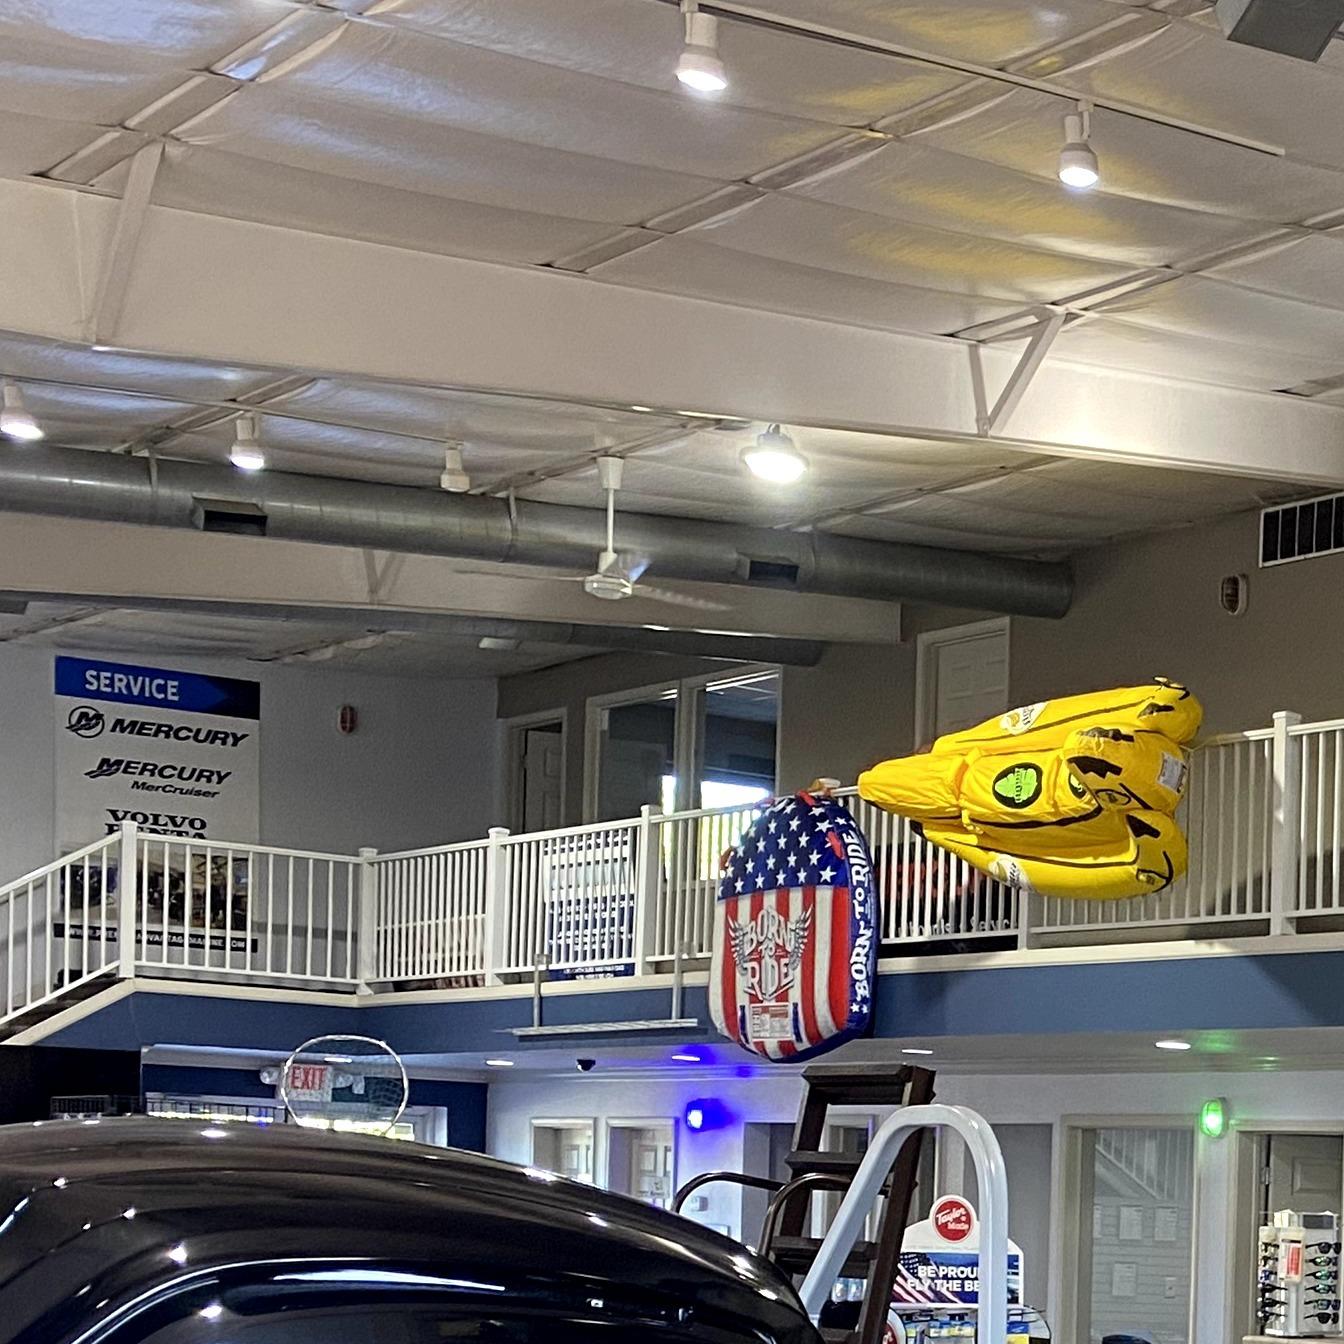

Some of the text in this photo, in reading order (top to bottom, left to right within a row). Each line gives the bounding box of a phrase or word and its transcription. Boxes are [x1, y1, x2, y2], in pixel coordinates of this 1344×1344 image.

[85, 669, 180, 701] SERVICE
[110, 718, 249, 747] MERCURY
[85, 757, 232, 785] MERCURY
[131, 780, 221, 798] MerCruiser
[106, 808, 207, 830] VOLVO
[843, 831, 869, 883] RIDE
[852, 887, 865, 920] TO
[744, 908, 795, 956] BORN
[758, 941, 776, 958] TO
[850, 921, 873, 1001] BORN
[744, 955, 795, 1000] RIDE
[291, 1065, 327, 1090] EXIT
[936, 1207, 967, 1226] Taylor
[907, 1279, 933, 1292] FLY
[934, 1279, 962, 1292] THE
[917, 1264, 979, 1279] BE PROU
